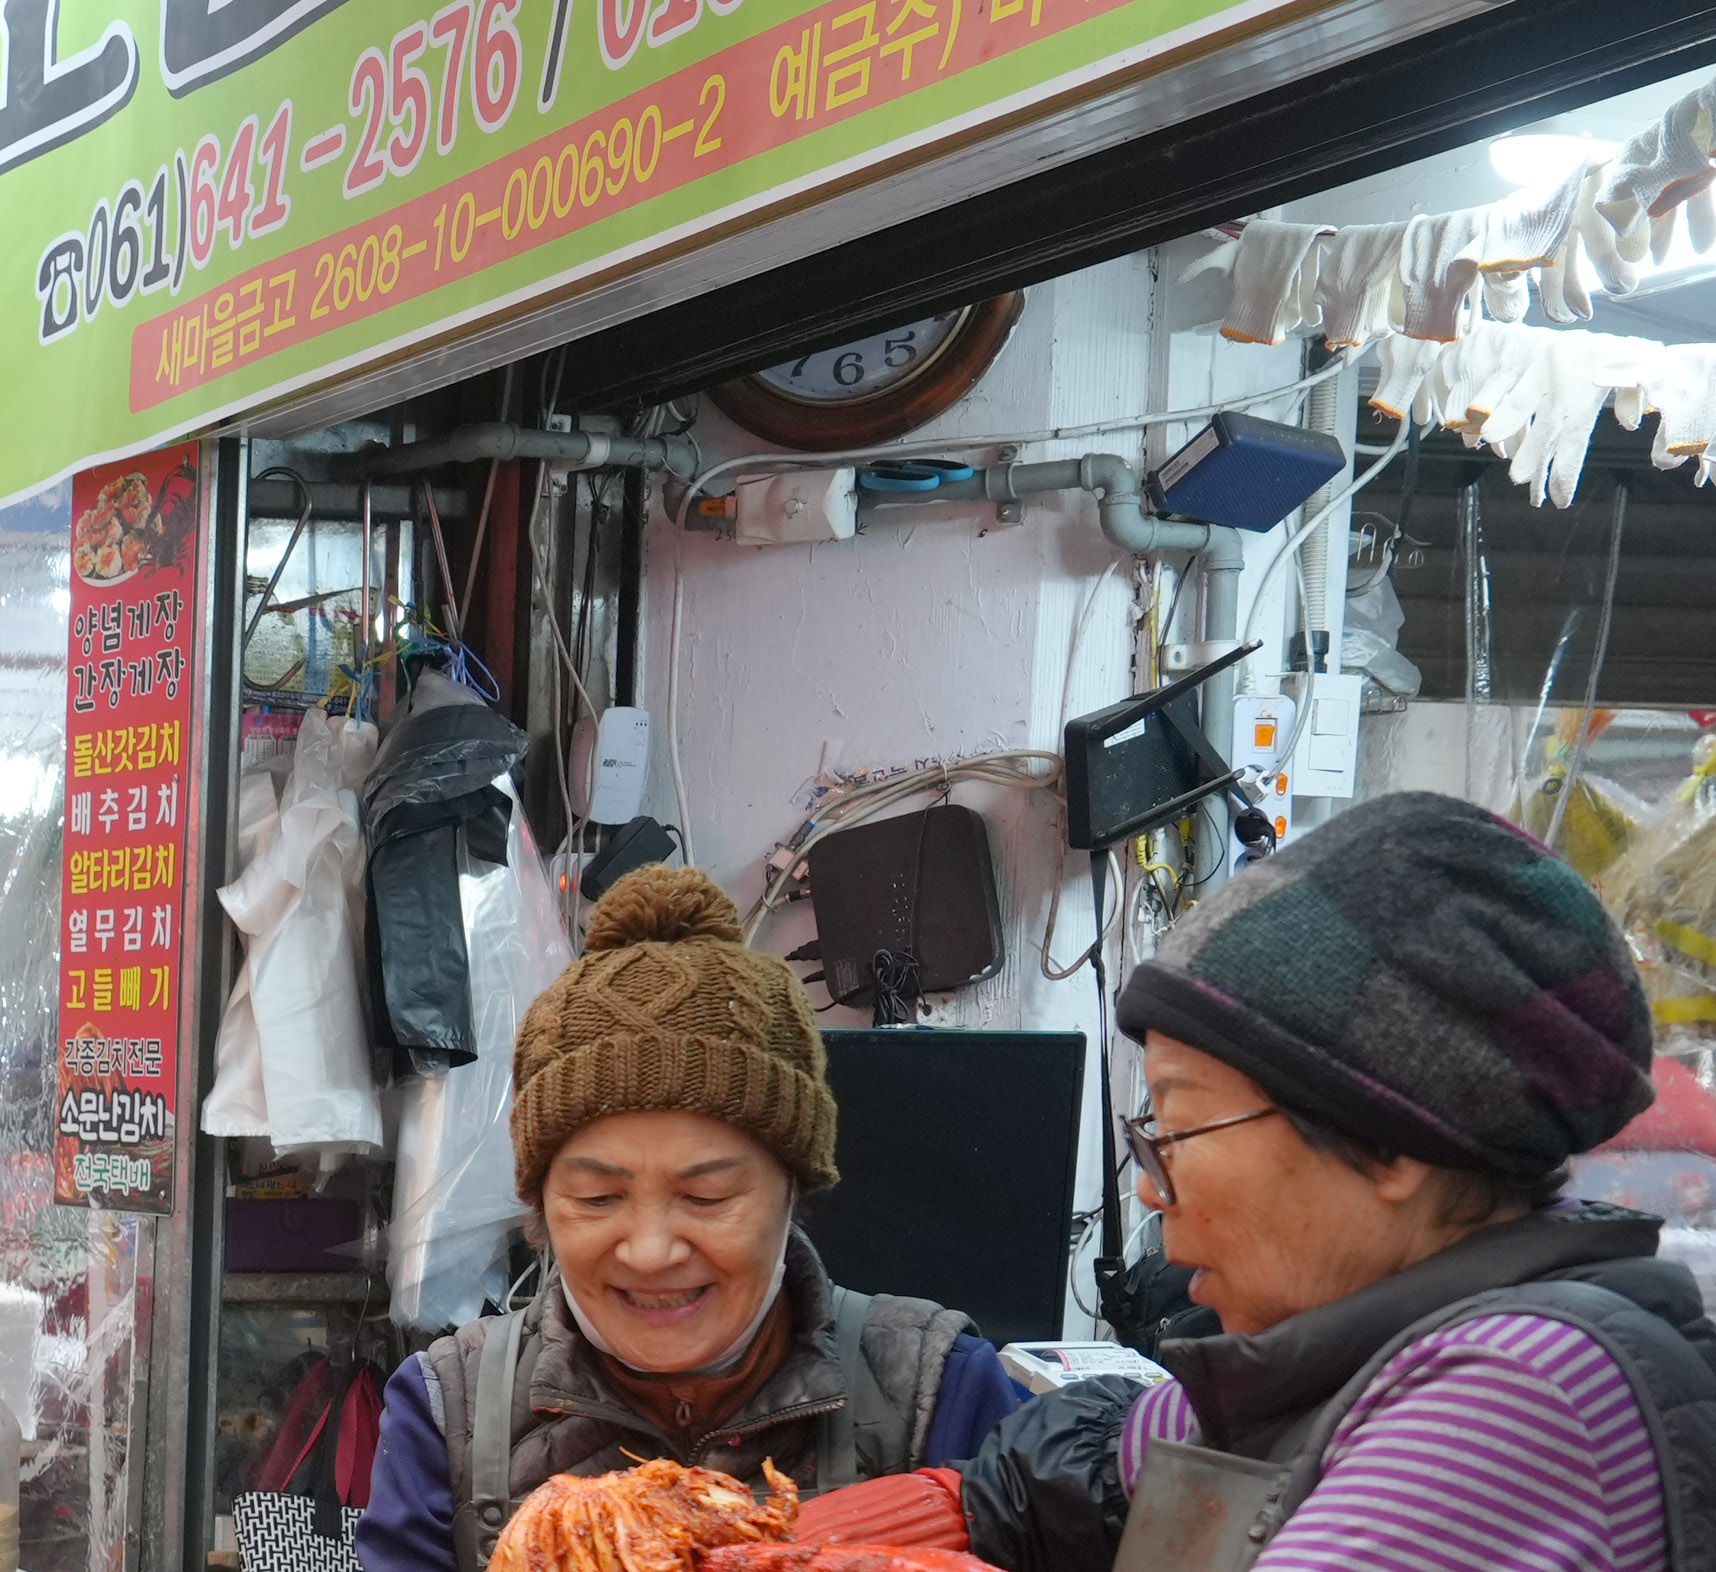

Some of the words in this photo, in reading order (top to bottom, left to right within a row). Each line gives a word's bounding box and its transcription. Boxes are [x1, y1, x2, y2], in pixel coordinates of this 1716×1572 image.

[85, 0, 520, 317] 061)641-2576
[155, 268, 298, 386] 새마을금고
[310, 73, 727, 321] 2608-10-000690-2
[833, 352, 866, 386] 6
[884, 331, 916, 368] 5
[73, 588, 185, 657] 양념게장
[72, 646, 186, 714] 간장게장
[72, 719, 182, 779] 돌산갓김치
[71, 779, 179, 836] 배추김치
[69, 842, 176, 896] 알타리김치
[68, 903, 173, 953] 열무김치
[65, 964, 171, 1012] 고들빼기
[64, 1037, 164, 1078] 각종김치전문
[59, 1086, 166, 1146] 소문난김치
[73, 1151, 152, 1197] 전국택배
